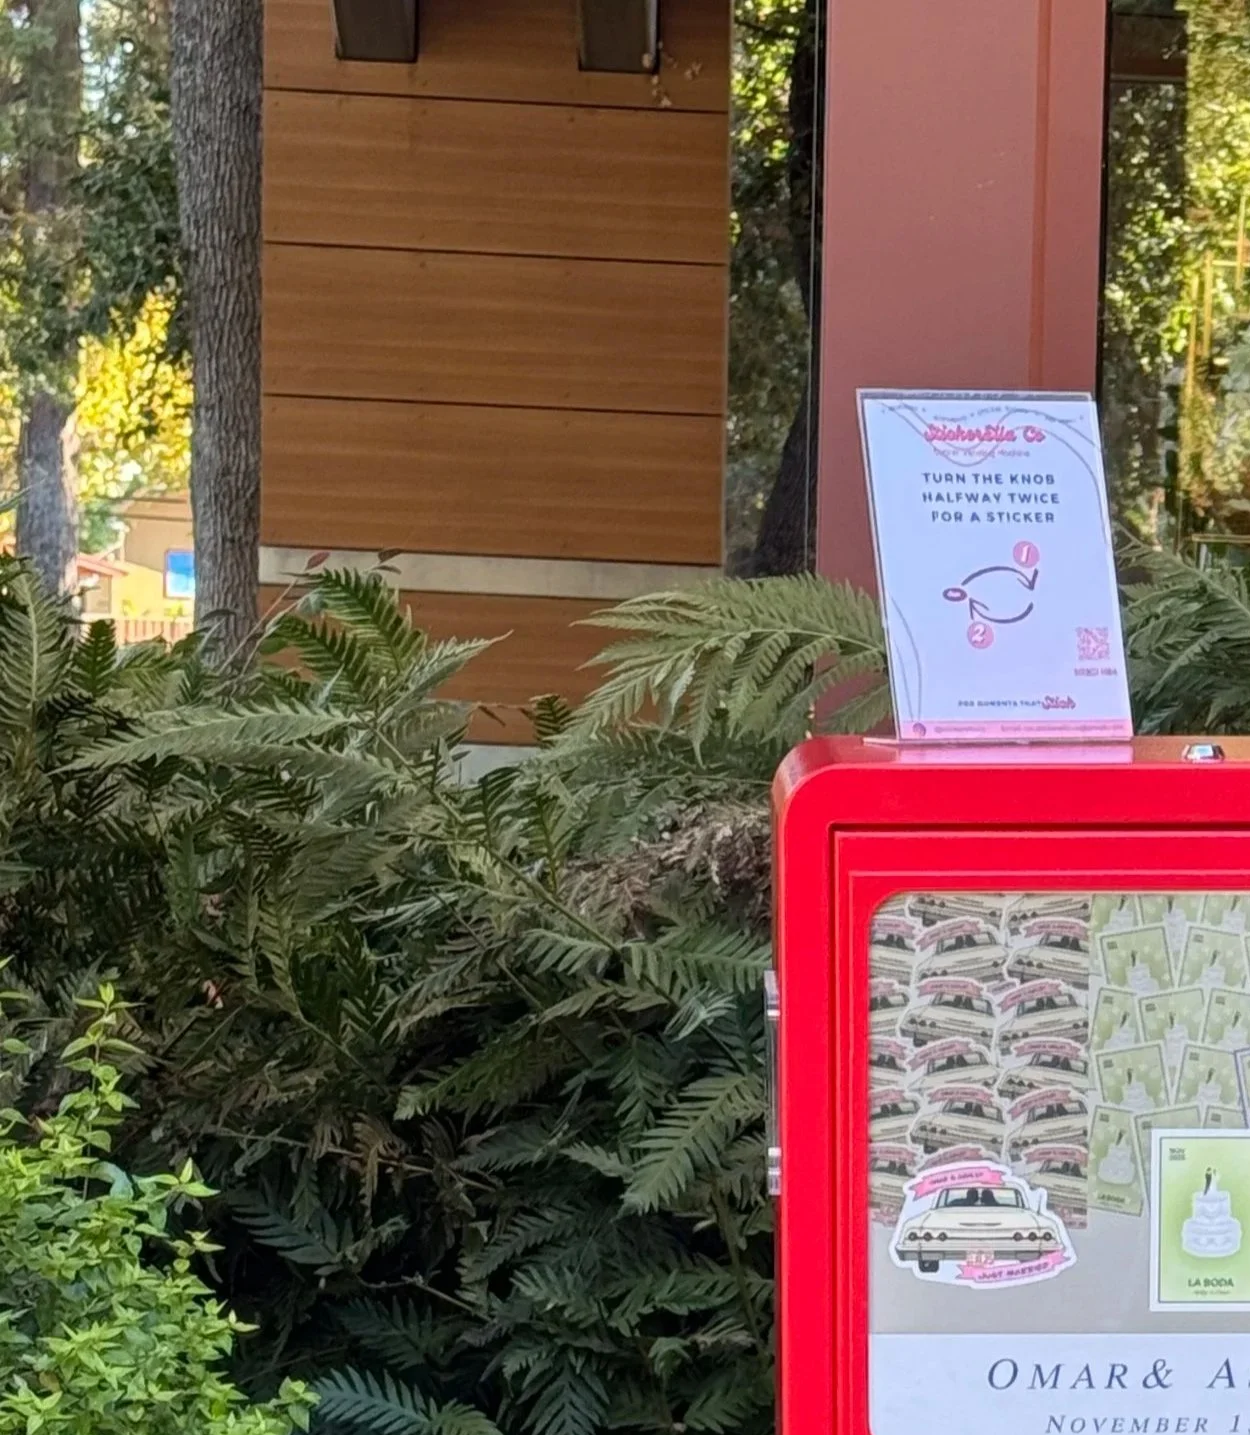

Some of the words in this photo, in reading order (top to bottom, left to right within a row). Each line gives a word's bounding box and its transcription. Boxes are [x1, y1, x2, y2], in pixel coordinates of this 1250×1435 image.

[922, 472, 966, 484] TURN
[972, 473, 1004, 484] THE
[1009, 473, 1055, 485] KNOB
[922, 492, 1001, 504] HALFWAY
[1007, 493, 1060, 504] TWICE
[931, 511, 963, 522] FOR
[970, 511, 981, 522] A
[986, 511, 1055, 523] STICKER
[971, 623, 987, 644] 2
[1187, 1278, 1201, 1287] LA
[1203, 1278, 1234, 1287] BODA
[1044, 1414, 1209, 1435] NOVEMBER
